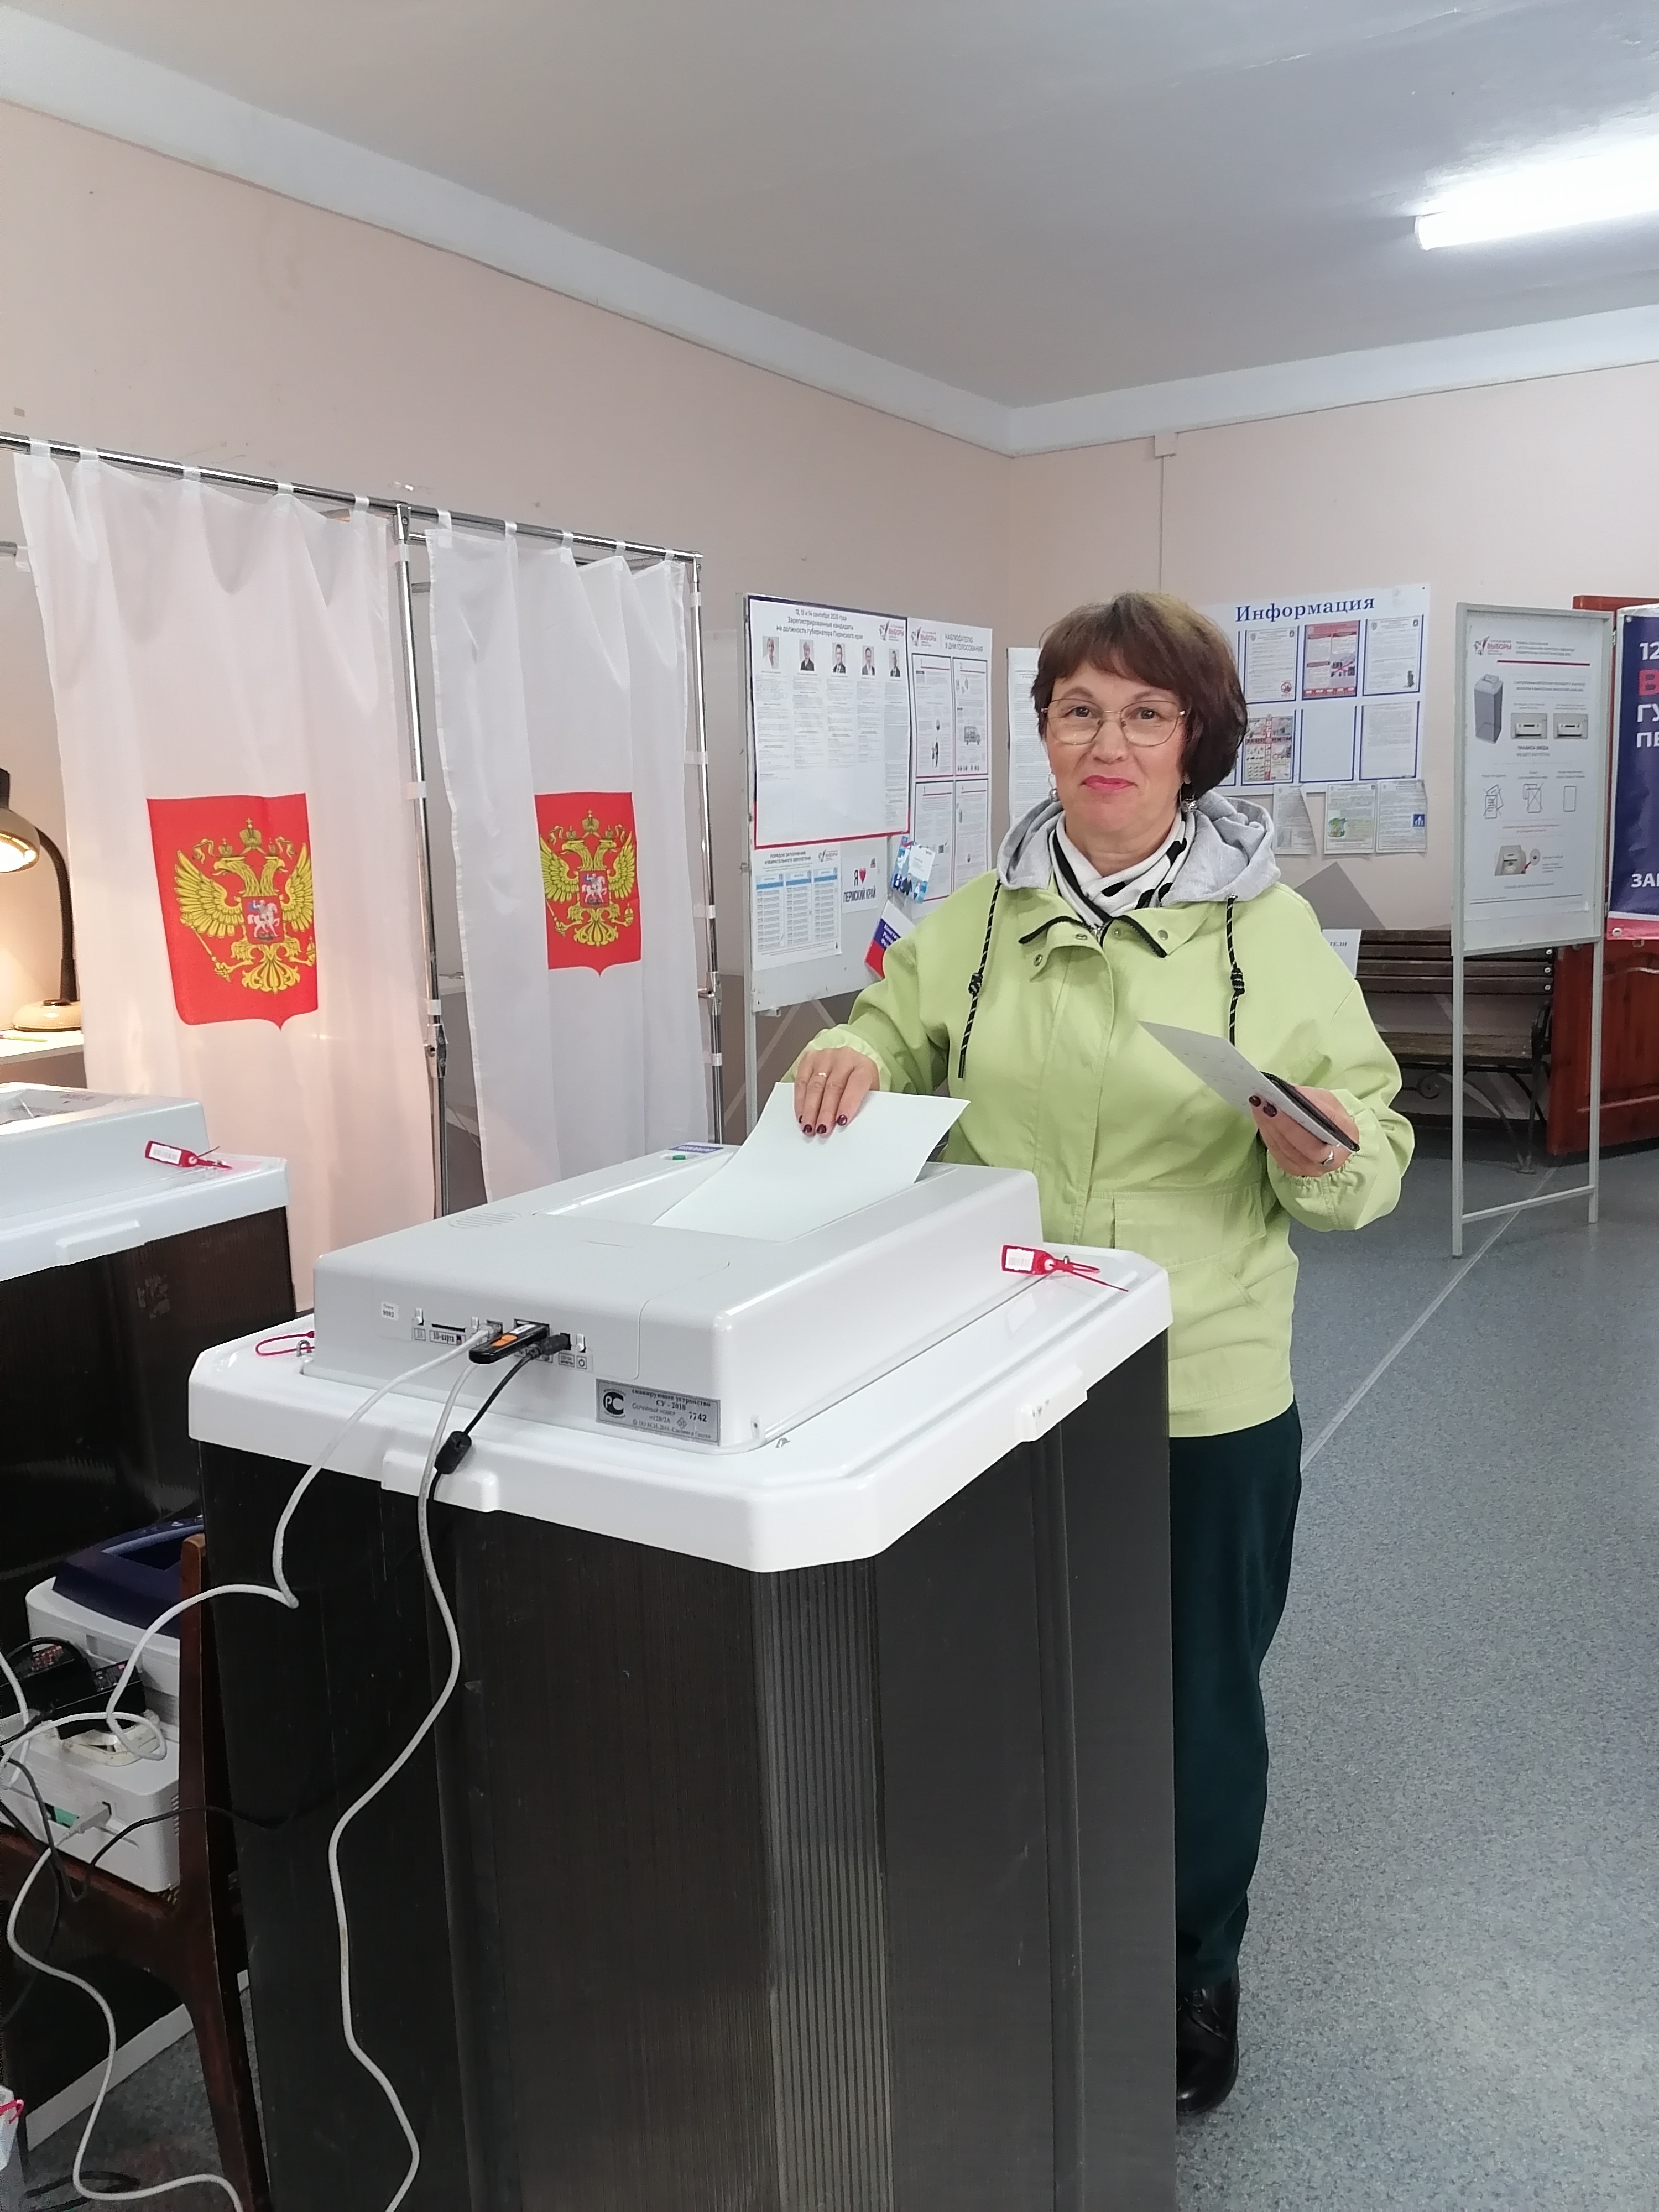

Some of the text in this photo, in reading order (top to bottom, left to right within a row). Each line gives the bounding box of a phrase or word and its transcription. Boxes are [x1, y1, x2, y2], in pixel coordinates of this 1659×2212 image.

[1235, 597, 1375, 622] Информация
[854, 870, 858, 886] Я
[1631, 873, 1659, 888] ЗА
[843, 885, 876, 903] ПЕРМСКИЙ КРАЙ
[632, 1389, 674, 1401] сканирующее
[676, 1396, 711, 1407] устройство
[671, 1402, 686, 1411] 2010
[688, 1411, 707, 1422] 7742
